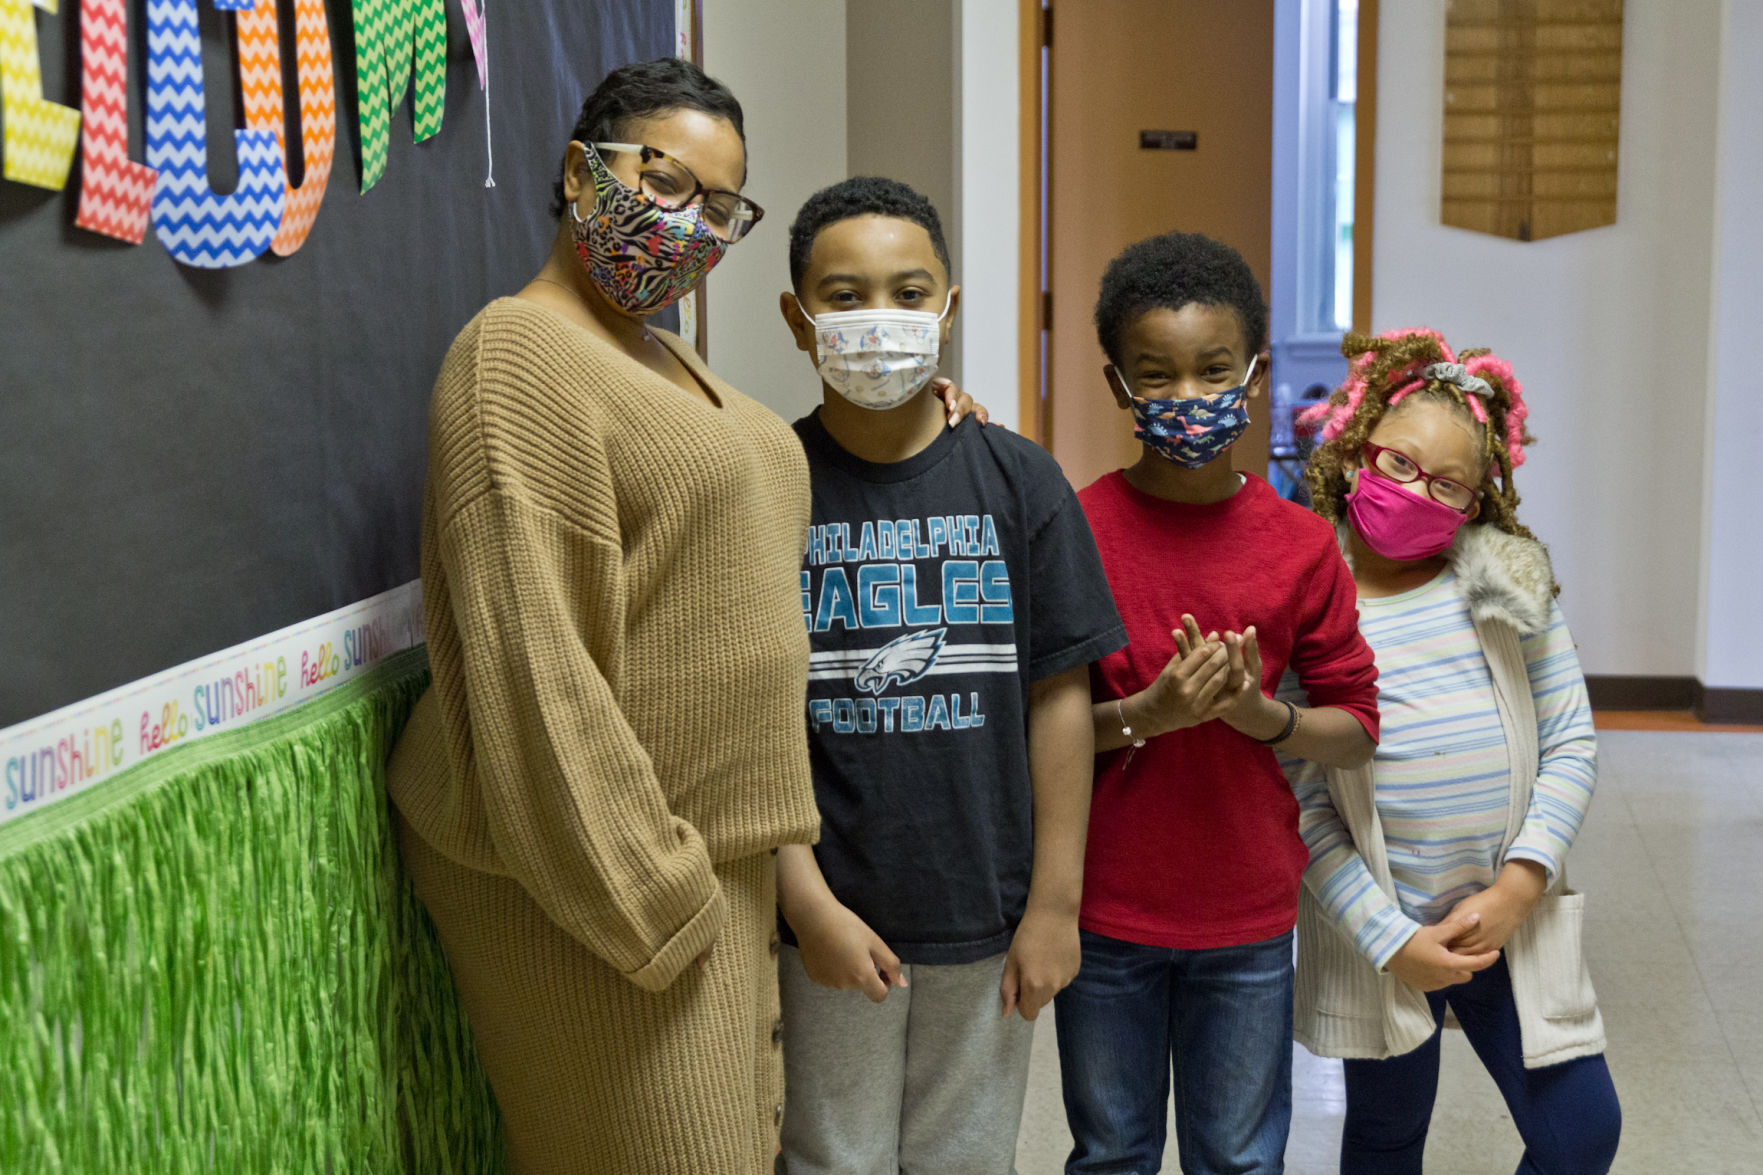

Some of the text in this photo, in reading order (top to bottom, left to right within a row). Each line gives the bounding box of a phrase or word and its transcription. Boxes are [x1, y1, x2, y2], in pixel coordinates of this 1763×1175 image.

[804, 514, 1000, 565] HILADELPHIA
[5, 717, 124, 811] sunshine
[139, 699, 188, 755] hello
[193, 656, 287, 732] sunshine
[300, 641, 340, 690] hello
[809, 692, 985, 734] FOOTBALL
